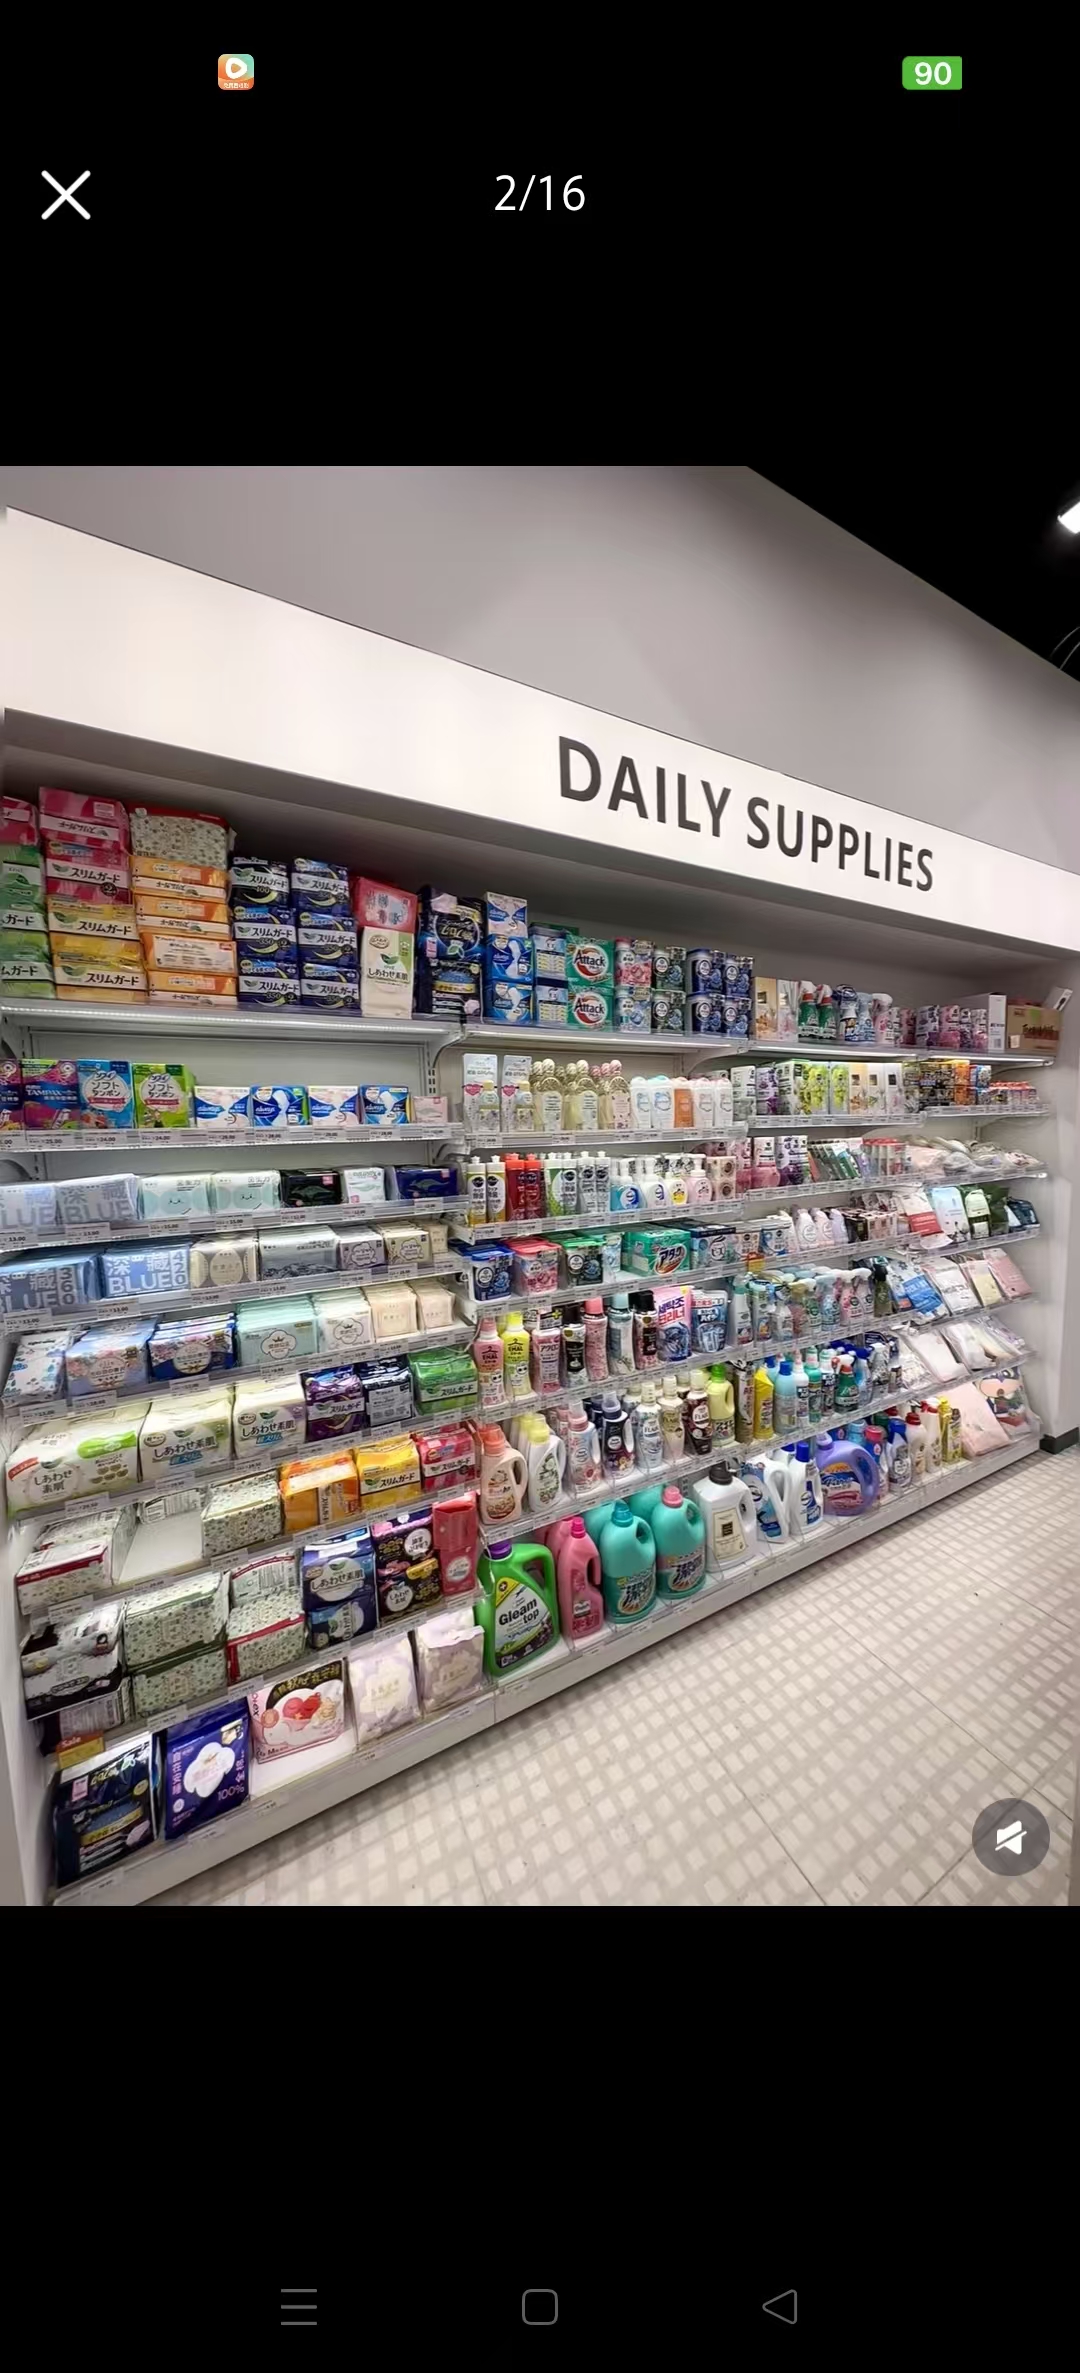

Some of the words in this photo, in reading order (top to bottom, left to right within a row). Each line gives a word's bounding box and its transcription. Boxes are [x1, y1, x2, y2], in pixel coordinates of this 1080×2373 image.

[559, 735, 731, 838] DAILY
[746, 796, 933, 892] SUPPLIES
[71, 867, 121, 883] スリムガード
[250, 875, 288, 888] スリムガード
[78, 919, 132, 935] スリムガード
[252, 927, 293, 938] スリムガード
[318, 933, 356, 945] スリムガード
[574, 953, 605, 967] Attack
[86, 972, 140, 985] スリムガード
[368, 967, 409, 981] しあわせ素肌
[258, 981, 300, 992] スリムガード
[320, 984, 357, 995] スリムガード
[574, 998, 605, 1013] Attack
[91, 1081, 120, 1090] ソフト
[92, 1089, 121, 1097] タンポン
[148, 1083, 174, 1092] ソフト
[64, 1199, 135, 1225] BLUE
[172, 1251, 189, 1287] 420
[108, 1272, 173, 1295] BLUE
[658, 1296, 685, 1314] 세탁조
[441, 1384, 474, 1397] スリムガード
[330, 1401, 361, 1414] スリムガード
[242, 1419, 296, 1438] しあわせ素肌
[154, 1436, 216, 1458] しあわせ素肌
[442, 1456, 472, 1471] スリムガード
[34, 1469, 73, 1486] しあわせ
[381, 1471, 416, 1488] スリムガード
[42, 1480, 65, 1494] 素肌
[312, 1570, 364, 1590] しあわせ素肌
[498, 1598, 538, 1626] Gleam
[523, 1608, 540, 1624] top
[61, 1736, 82, 1748] Sale
[217, 1783, 246, 1801] 100%
